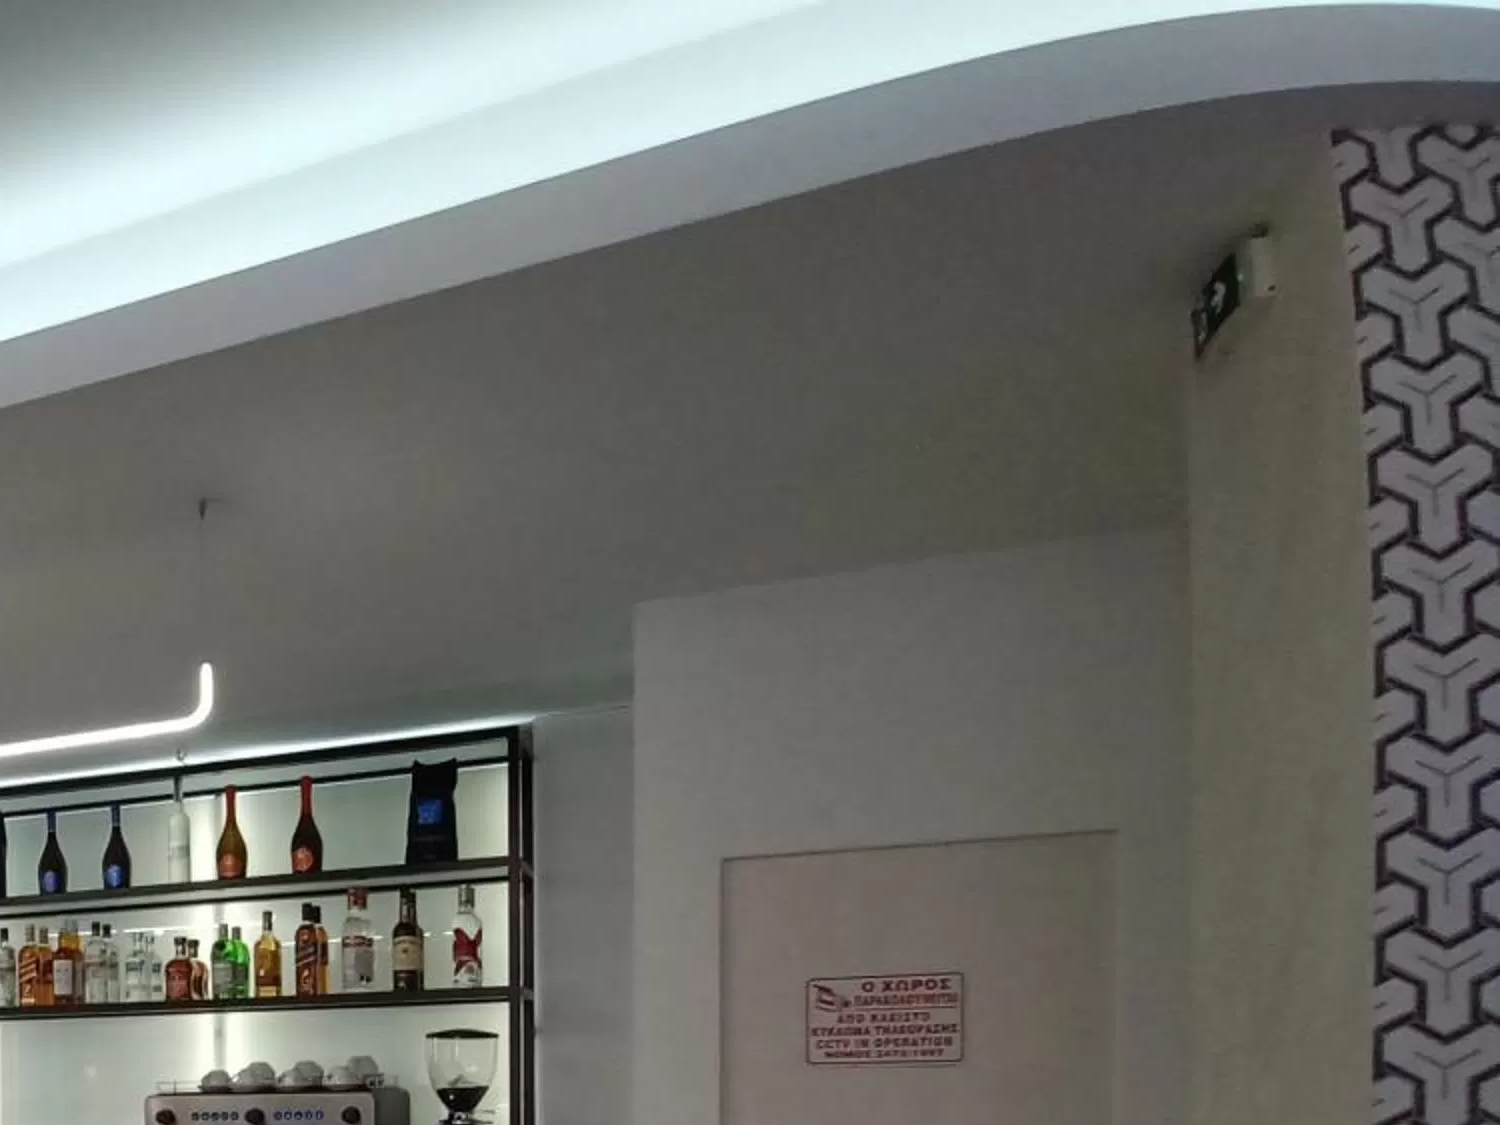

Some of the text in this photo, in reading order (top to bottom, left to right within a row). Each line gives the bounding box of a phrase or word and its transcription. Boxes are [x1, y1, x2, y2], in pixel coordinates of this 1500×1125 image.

[882, 978, 953, 992] ΧΩΡΟΣ
[816, 1039, 850, 1049] CCTV
[874, 1036, 953, 1048] OPERATION
